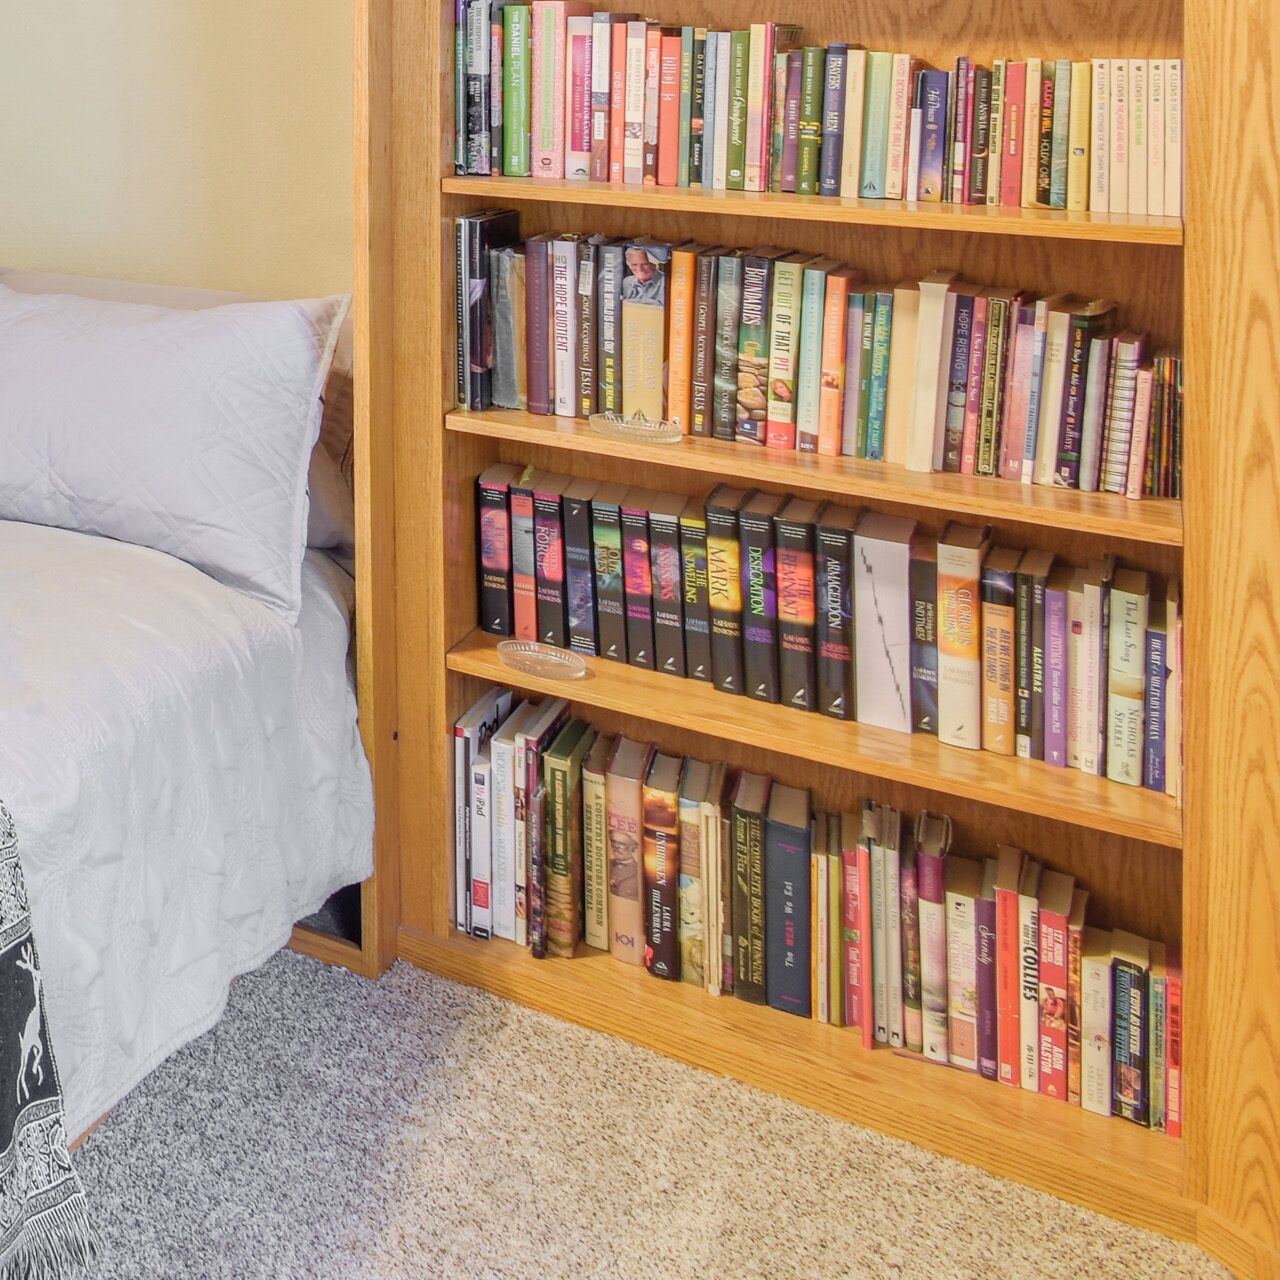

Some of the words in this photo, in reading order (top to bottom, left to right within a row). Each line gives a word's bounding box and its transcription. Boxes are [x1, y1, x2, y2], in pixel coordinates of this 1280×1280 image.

[475, 18, 483, 51] GUIDEPOSTS
[511, 24, 519, 58] DANIEL
[511, 61, 519, 87] PLAN
[696, 54, 704, 71] DAY
[828, 57, 842, 89] PRAYERS
[612, 71, 622, 109] ordinary
[695, 74, 703, 83] BY
[695, 88, 703, 103] DAY
[788, 100, 797, 120] heroic
[827, 111, 839, 132] MEN
[978, 102, 988, 129] ANSWER
[788, 123, 796, 139] faith
[1042, 116, 1052, 133] HELL
[555, 265, 566, 281] THE
[603, 253, 614, 269] WHAT
[779, 270, 793, 286] GET
[555, 283, 567, 307] HOPE
[581, 295, 590, 319] GOSPEL
[603, 293, 614, 315] WORLD
[742, 267, 767, 326] BOUNDARIES
[779, 292, 793, 310] OUT
[698, 305, 707, 330] GOSPEL
[721, 303, 732, 345] SHIPWRECK
[777, 314, 792, 325] OF
[957, 309, 969, 335] HOPE
[555, 310, 568, 353] QUOTIENT
[581, 320, 591, 363] ACCORDING
[603, 322, 615, 340] GOING
[775, 330, 791, 353] THAT
[696, 335, 706, 376] ACCORDING
[955, 338, 967, 369] RISING
[974, 338, 982, 350] New
[1071, 348, 1082, 363] Study
[721, 360, 731, 380] PAUL
[774, 357, 789, 372] PIT
[579, 367, 593, 395] JESUS
[971, 375, 979, 386] New
[692, 381, 708, 410] JESUS
[970, 388, 978, 401] Start
[536, 525, 547, 570] FORCE
[548, 527, 558, 571] TRIBULATION
[658, 543, 674, 601] ASSASSINS
[684, 549, 696, 603] INDWELLING
[696, 568, 707, 587] THE
[710, 547, 729, 600] MARK
[729, 567, 738, 582] THE
[749, 546, 764, 616] DESECRATION
[782, 554, 798, 619] REMNANT
[799, 577, 812, 600] THE
[827, 557, 842, 629] ARMAGEDDON
[915, 600, 925, 616] END
[957, 589, 972, 646] GLORIOUS
[1126, 600, 1138, 617] The
[914, 617, 925, 640] TIMES?
[986, 626, 997, 640] THE
[1000, 629, 1010, 643] ARE
[1124, 620, 1135, 638] Last
[986, 642, 997, 656] END
[1000, 643, 1010, 655] WE
[1121, 641, 1136, 663] Song
[1150, 638, 1162, 665] HEART
[986, 657, 998, 684] TIMES?
[1000, 657, 1011, 682] LIVING
[1033, 647, 1042, 693] ALCATRAZ
[1000, 683, 1010, 692] IN
[1149, 676, 1161, 709] MILITARY
[1069, 688, 1082, 742] Relationships
[1149, 710, 1160, 740] WOMAN
[1114, 710, 1126, 750] SPARKS
[1127, 709, 1139, 758] NICHOLAS
[474, 785, 485, 796] My
[594, 793, 602, 801] A
[475, 797, 486, 817] iPad
[496, 792, 508, 827] health
[584, 803, 592, 834] SENSE
[595, 802, 603, 844] COUNTRY
[736, 814, 747, 843] James
[750, 818, 760, 839] THE
[585, 836, 593, 872] HEALTH
[595, 846, 604, 886] DOCTOR'S
[655, 832, 666, 886] UNBROKEN
[736, 852, 747, 873] Fixx
[750, 841, 762, 894] COMPLETE
[585, 873, 593, 911] MANUAL
[784, 881, 794, 896] Eat
[595, 887, 604, 926] COMMON
[651, 889, 662, 944] HILLENBRAND
[662, 905, 671, 932] LAURA
[751, 896, 762, 925] BOOK
[784, 901, 793, 915] We
[751, 926, 762, 936] of
[1054, 929, 1063, 942] 127
[978, 925, 995, 965] Serenity
[1054, 942, 1063, 967] HOURS
[752, 938, 763, 985] RUNNING
[785, 952, 794, 968] The
[1023, 946, 1037, 1002] COLLIES
[1041, 1035, 1052, 1074] RALSTON
[1052, 1045, 1063, 1070] ARON
